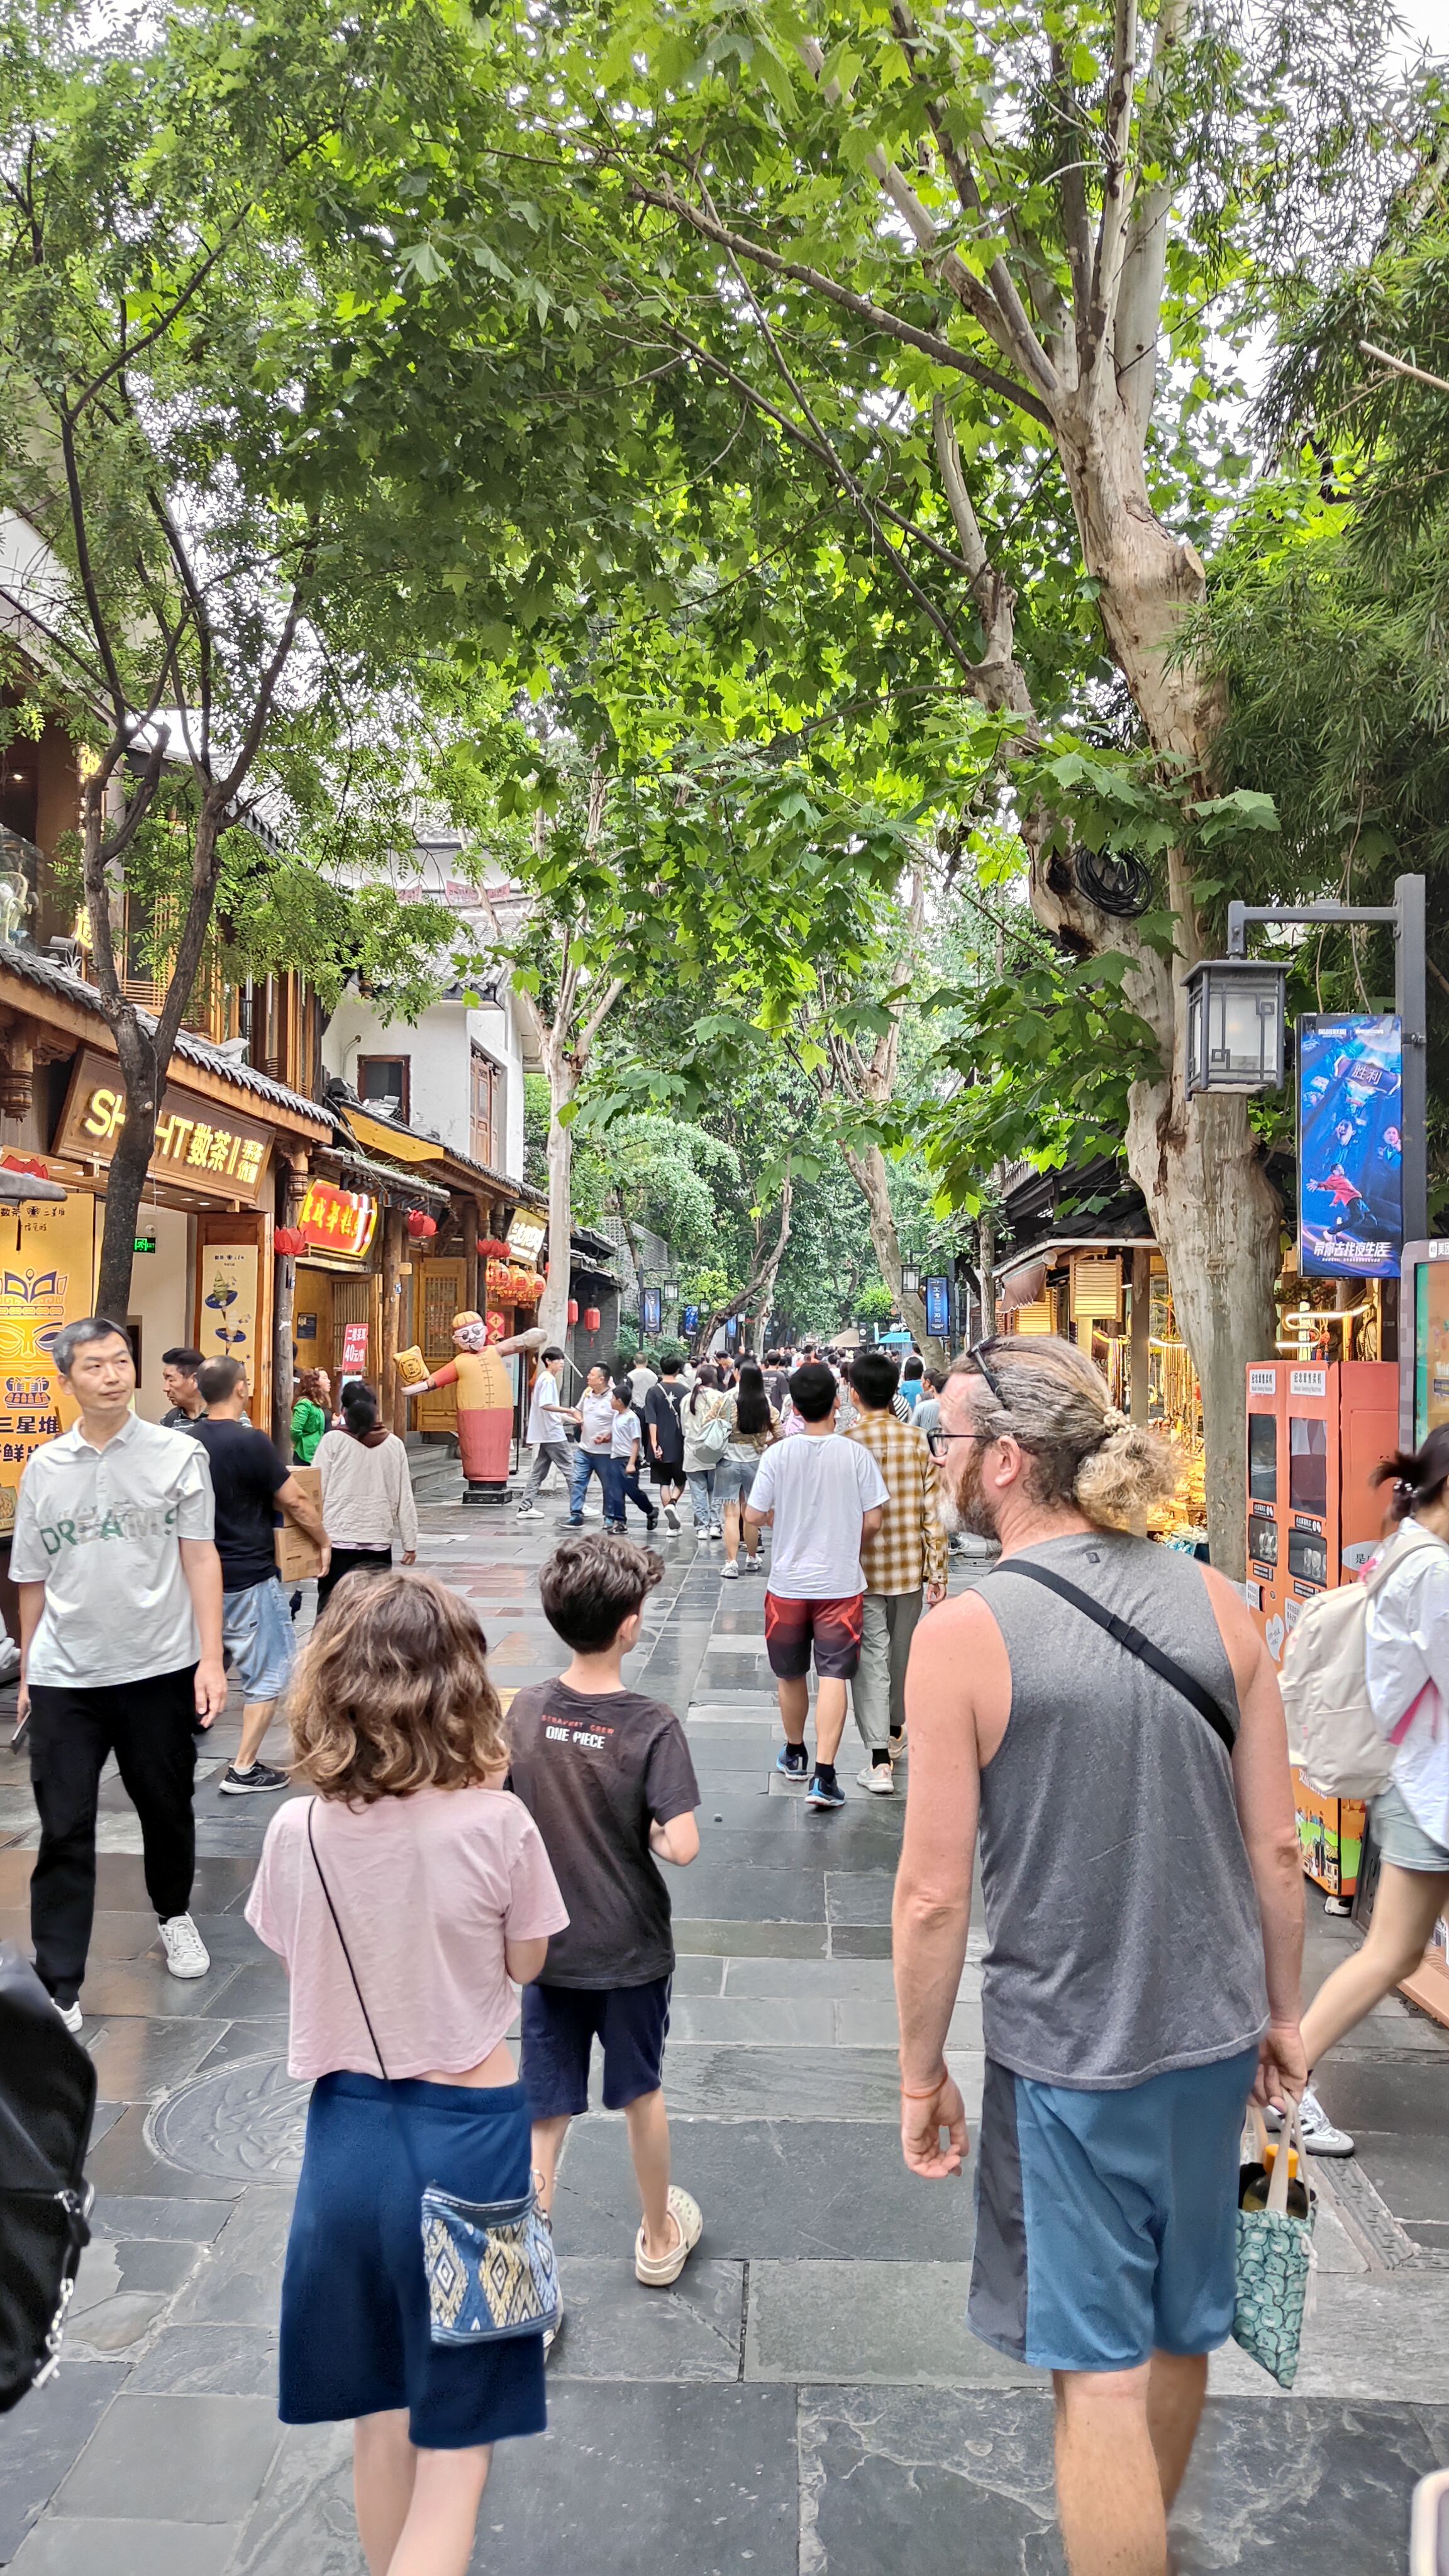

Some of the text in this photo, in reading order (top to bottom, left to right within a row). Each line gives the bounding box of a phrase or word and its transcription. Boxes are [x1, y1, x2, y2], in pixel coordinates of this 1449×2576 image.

[1352, 1065, 1382, 1086] 胜利
[1313, 1241, 1392, 1257] 带你去找夜生活
[1294, 1372, 1321, 1384] 纪念章售卖机
[546, 1726, 606, 1749] ONE PIECE
[590, 1724, 614, 1735] CREW
